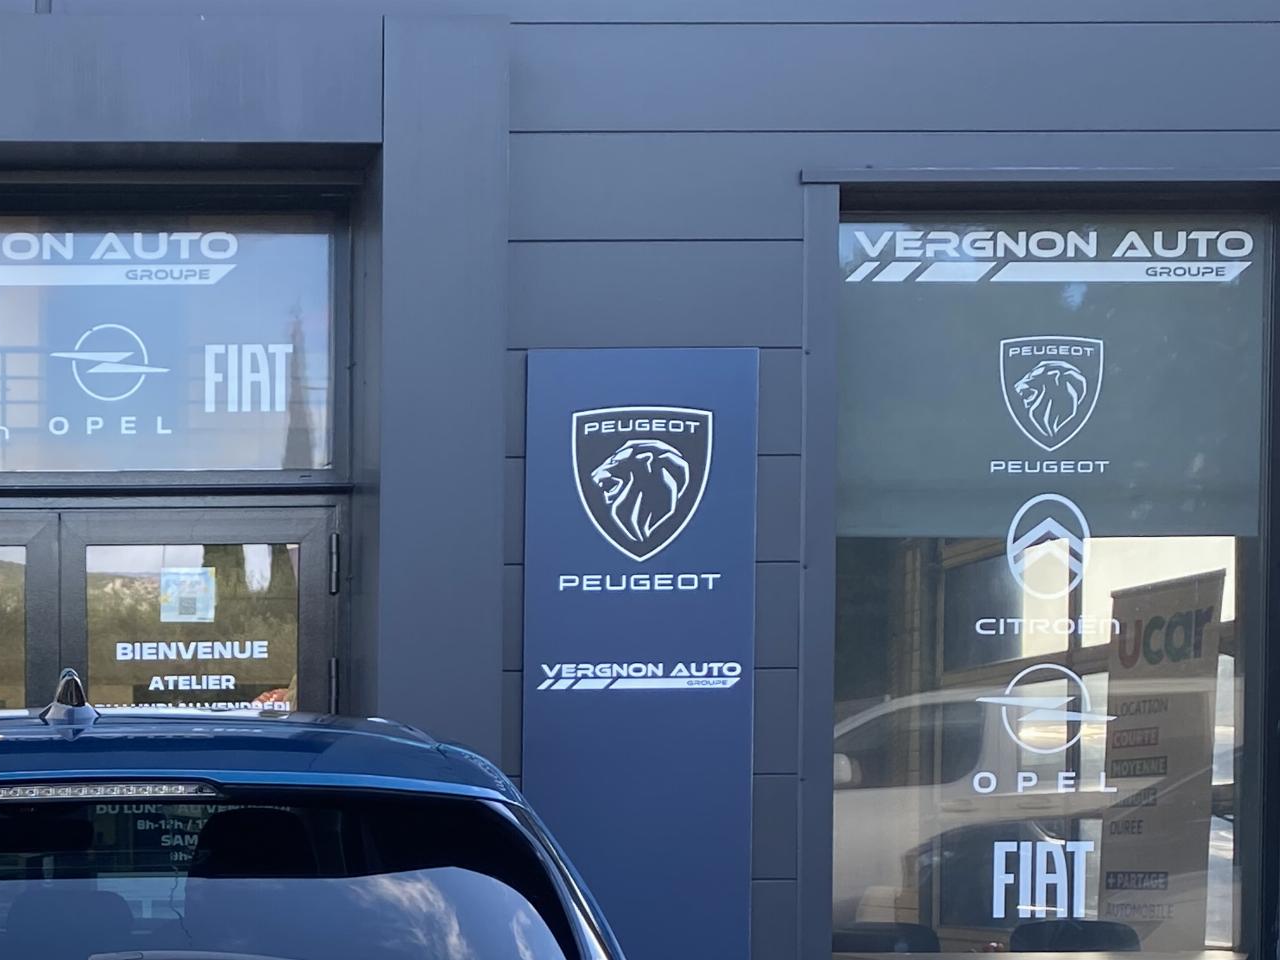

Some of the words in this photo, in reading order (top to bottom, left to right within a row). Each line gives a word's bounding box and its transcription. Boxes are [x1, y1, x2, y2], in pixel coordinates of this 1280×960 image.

[90, 232, 238, 260] AUTO
[854, 230, 1097, 258] VERGNON
[1112, 230, 1254, 258] AUTO
[125, 268, 211, 281] GROUPE
[1145, 266, 1226, 277] GROUPE
[1008, 346, 1094, 357] PEUGEOT
[204, 344, 293, 413] FIAT
[49, 417, 172, 435] OPEL
[584, 420, 700, 434] PEUGEOT
[990, 461, 1109, 473] PEUGEOT
[559, 574, 721, 590] PEUGEOT
[1119, 606, 1214, 668] ucar
[116, 641, 268, 660] BIENVENUE
[541, 663, 663, 677] VERGNON
[670, 663, 742, 676] AUTO
[148, 675, 235, 690] ATELIER
[973, 772, 1117, 793] OPEL
[992, 841, 1094, 918] FIAT
